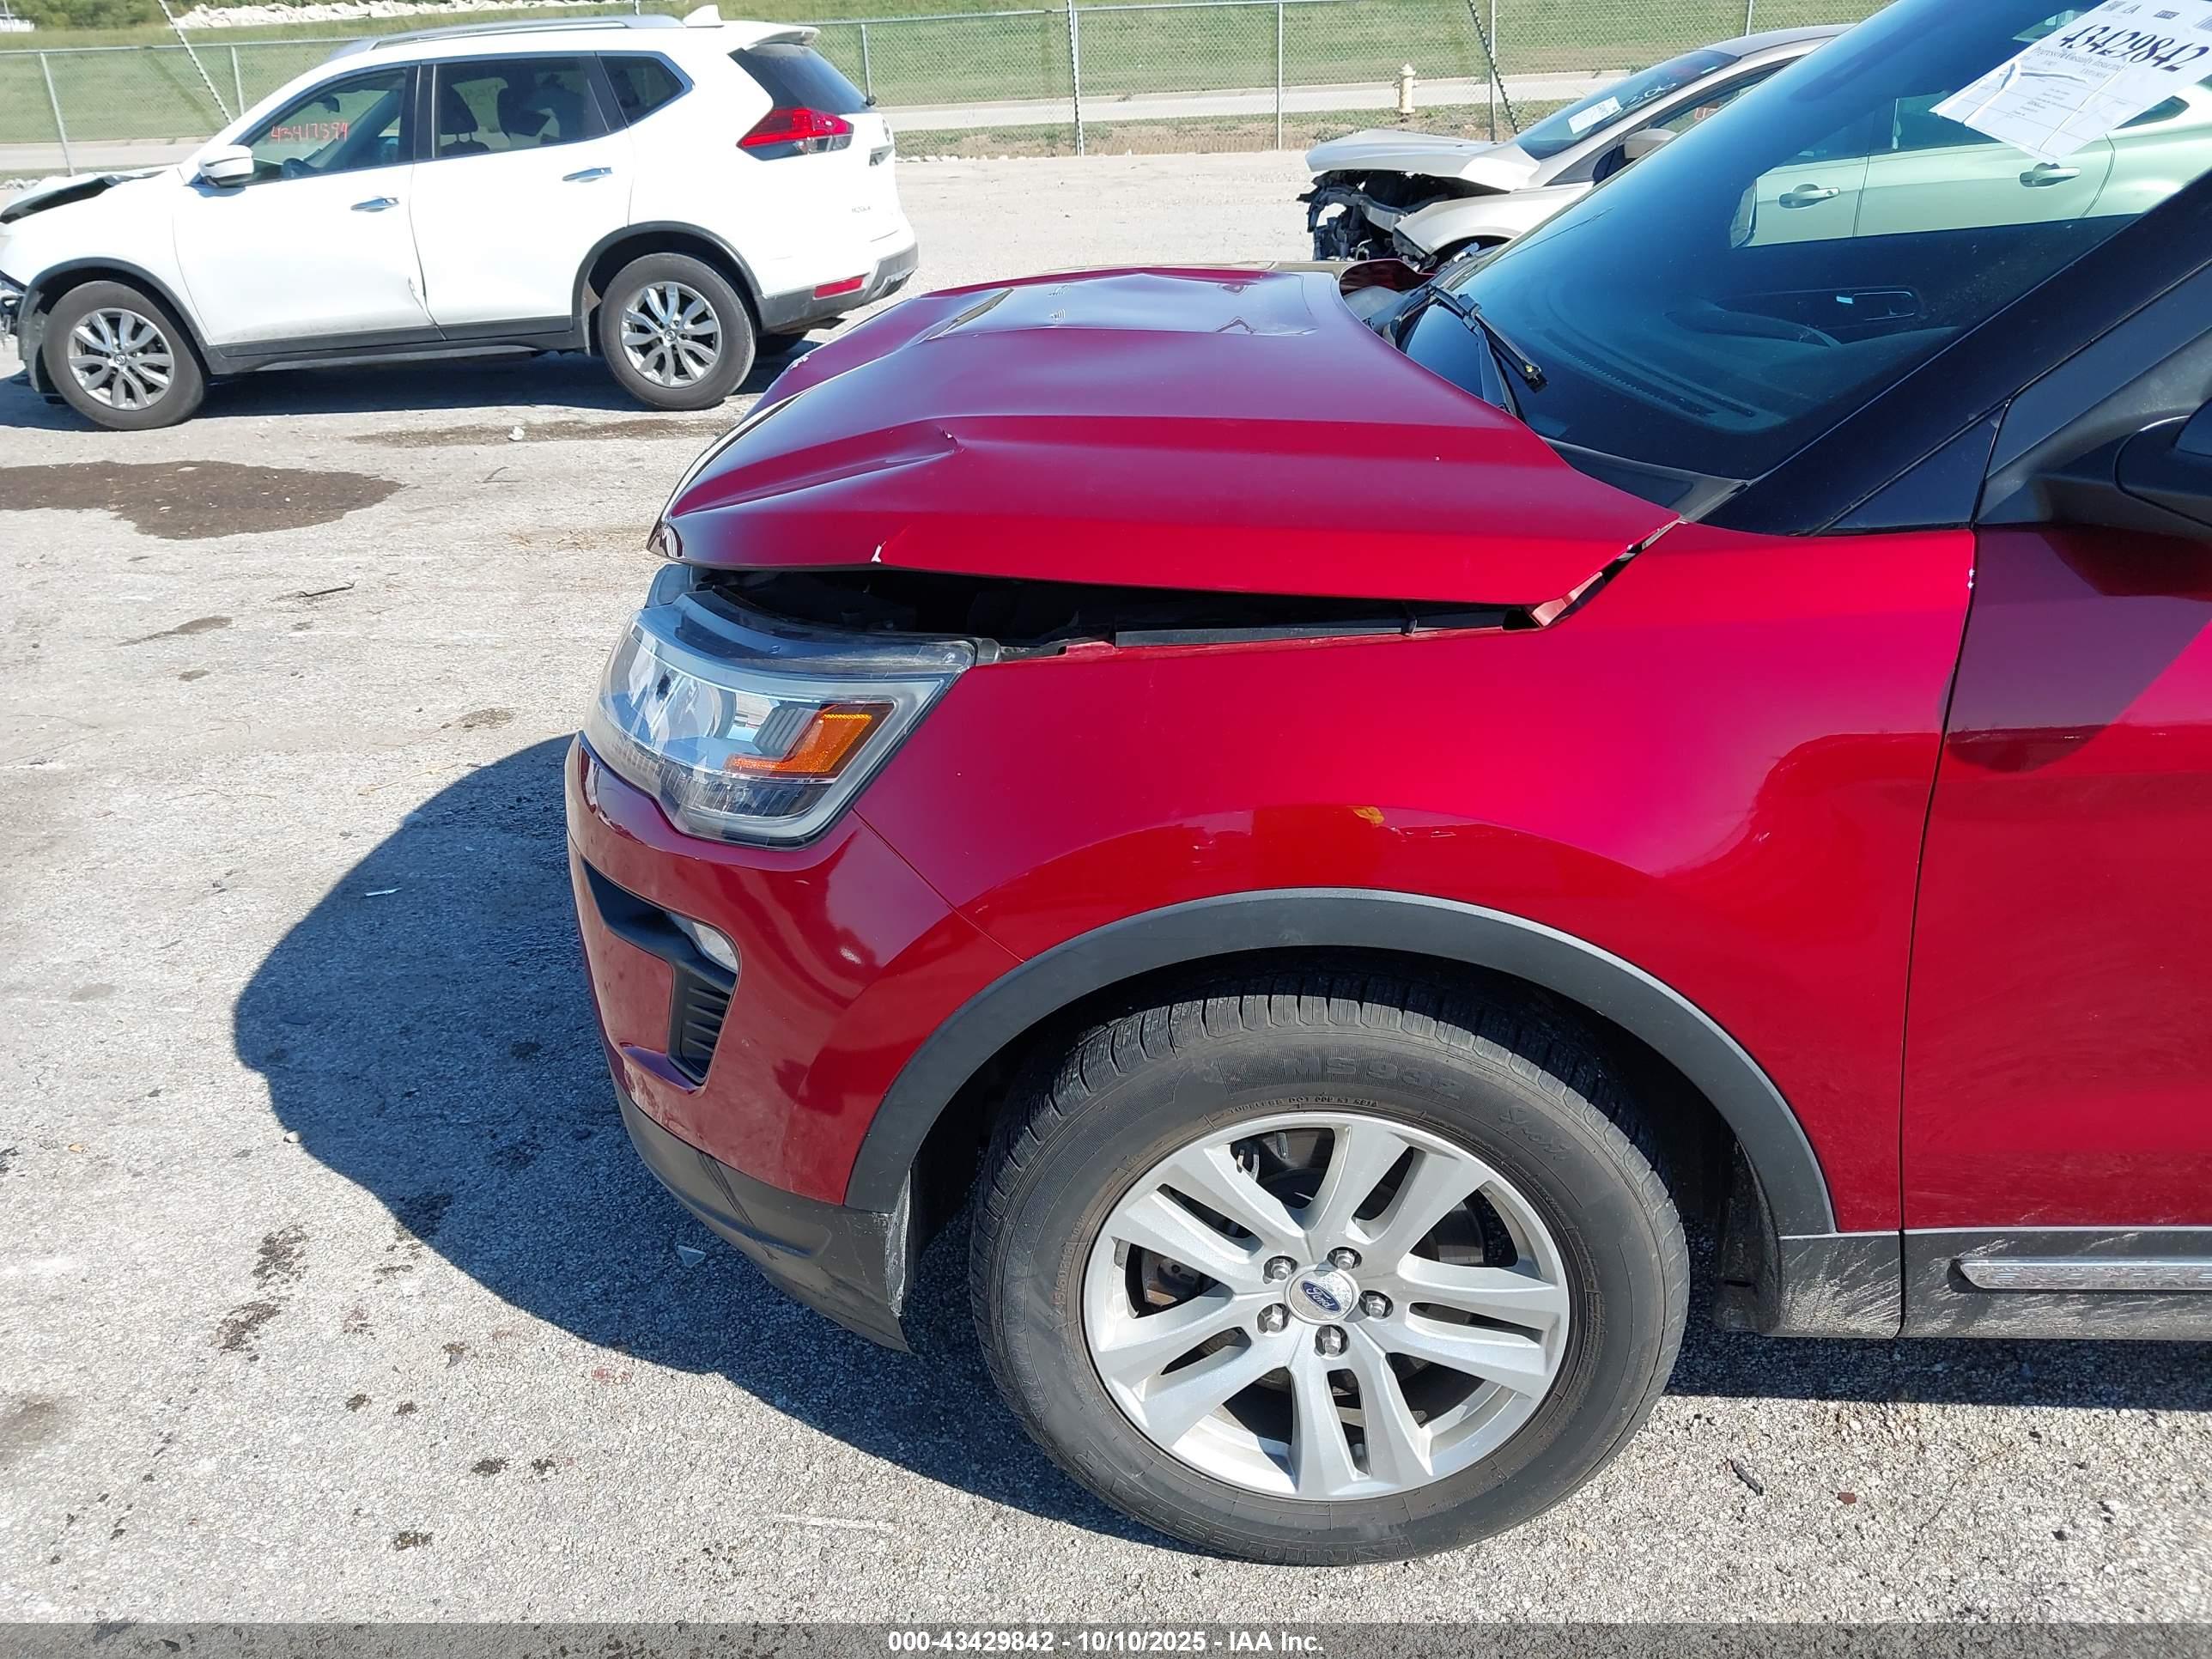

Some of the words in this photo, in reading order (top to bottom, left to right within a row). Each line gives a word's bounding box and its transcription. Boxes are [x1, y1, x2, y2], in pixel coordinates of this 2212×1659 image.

[2059, 24, 2209, 72] 43429842
[270, 121, 349, 144] 43417594
[1304, 1285, 1335, 1310] Ford
